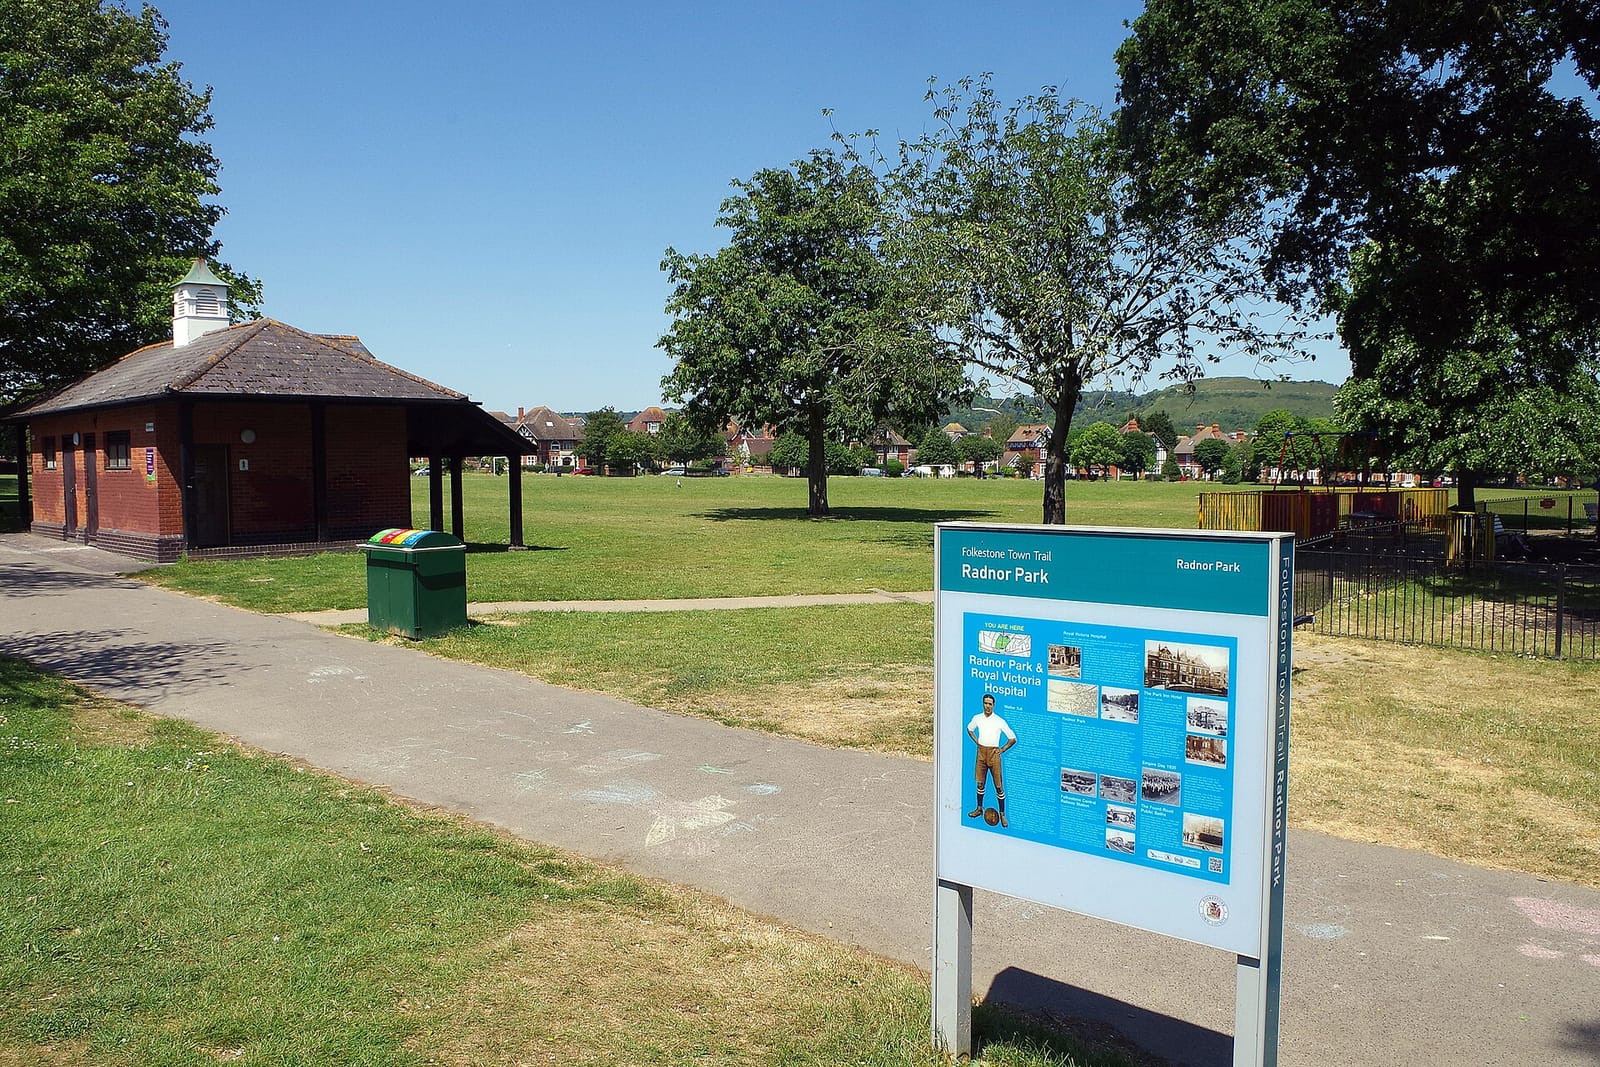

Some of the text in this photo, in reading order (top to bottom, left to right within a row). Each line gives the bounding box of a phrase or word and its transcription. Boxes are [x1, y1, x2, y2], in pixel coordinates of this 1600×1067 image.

[962, 547, 1052, 562] Folkestone Town Trail
[962, 564, 1049, 584] Radnor Park
[1176, 559, 1241, 573] Radnor Park
[1010, 624, 1025, 632] HERE
[969, 654, 1044, 674] Radnor Park &
[971, 667, 1042, 687] Royal Victoria
[984, 682, 1027, 697] Hospital
[1272, 556, 1290, 888] Folkestone Town Trail Radnor Park
